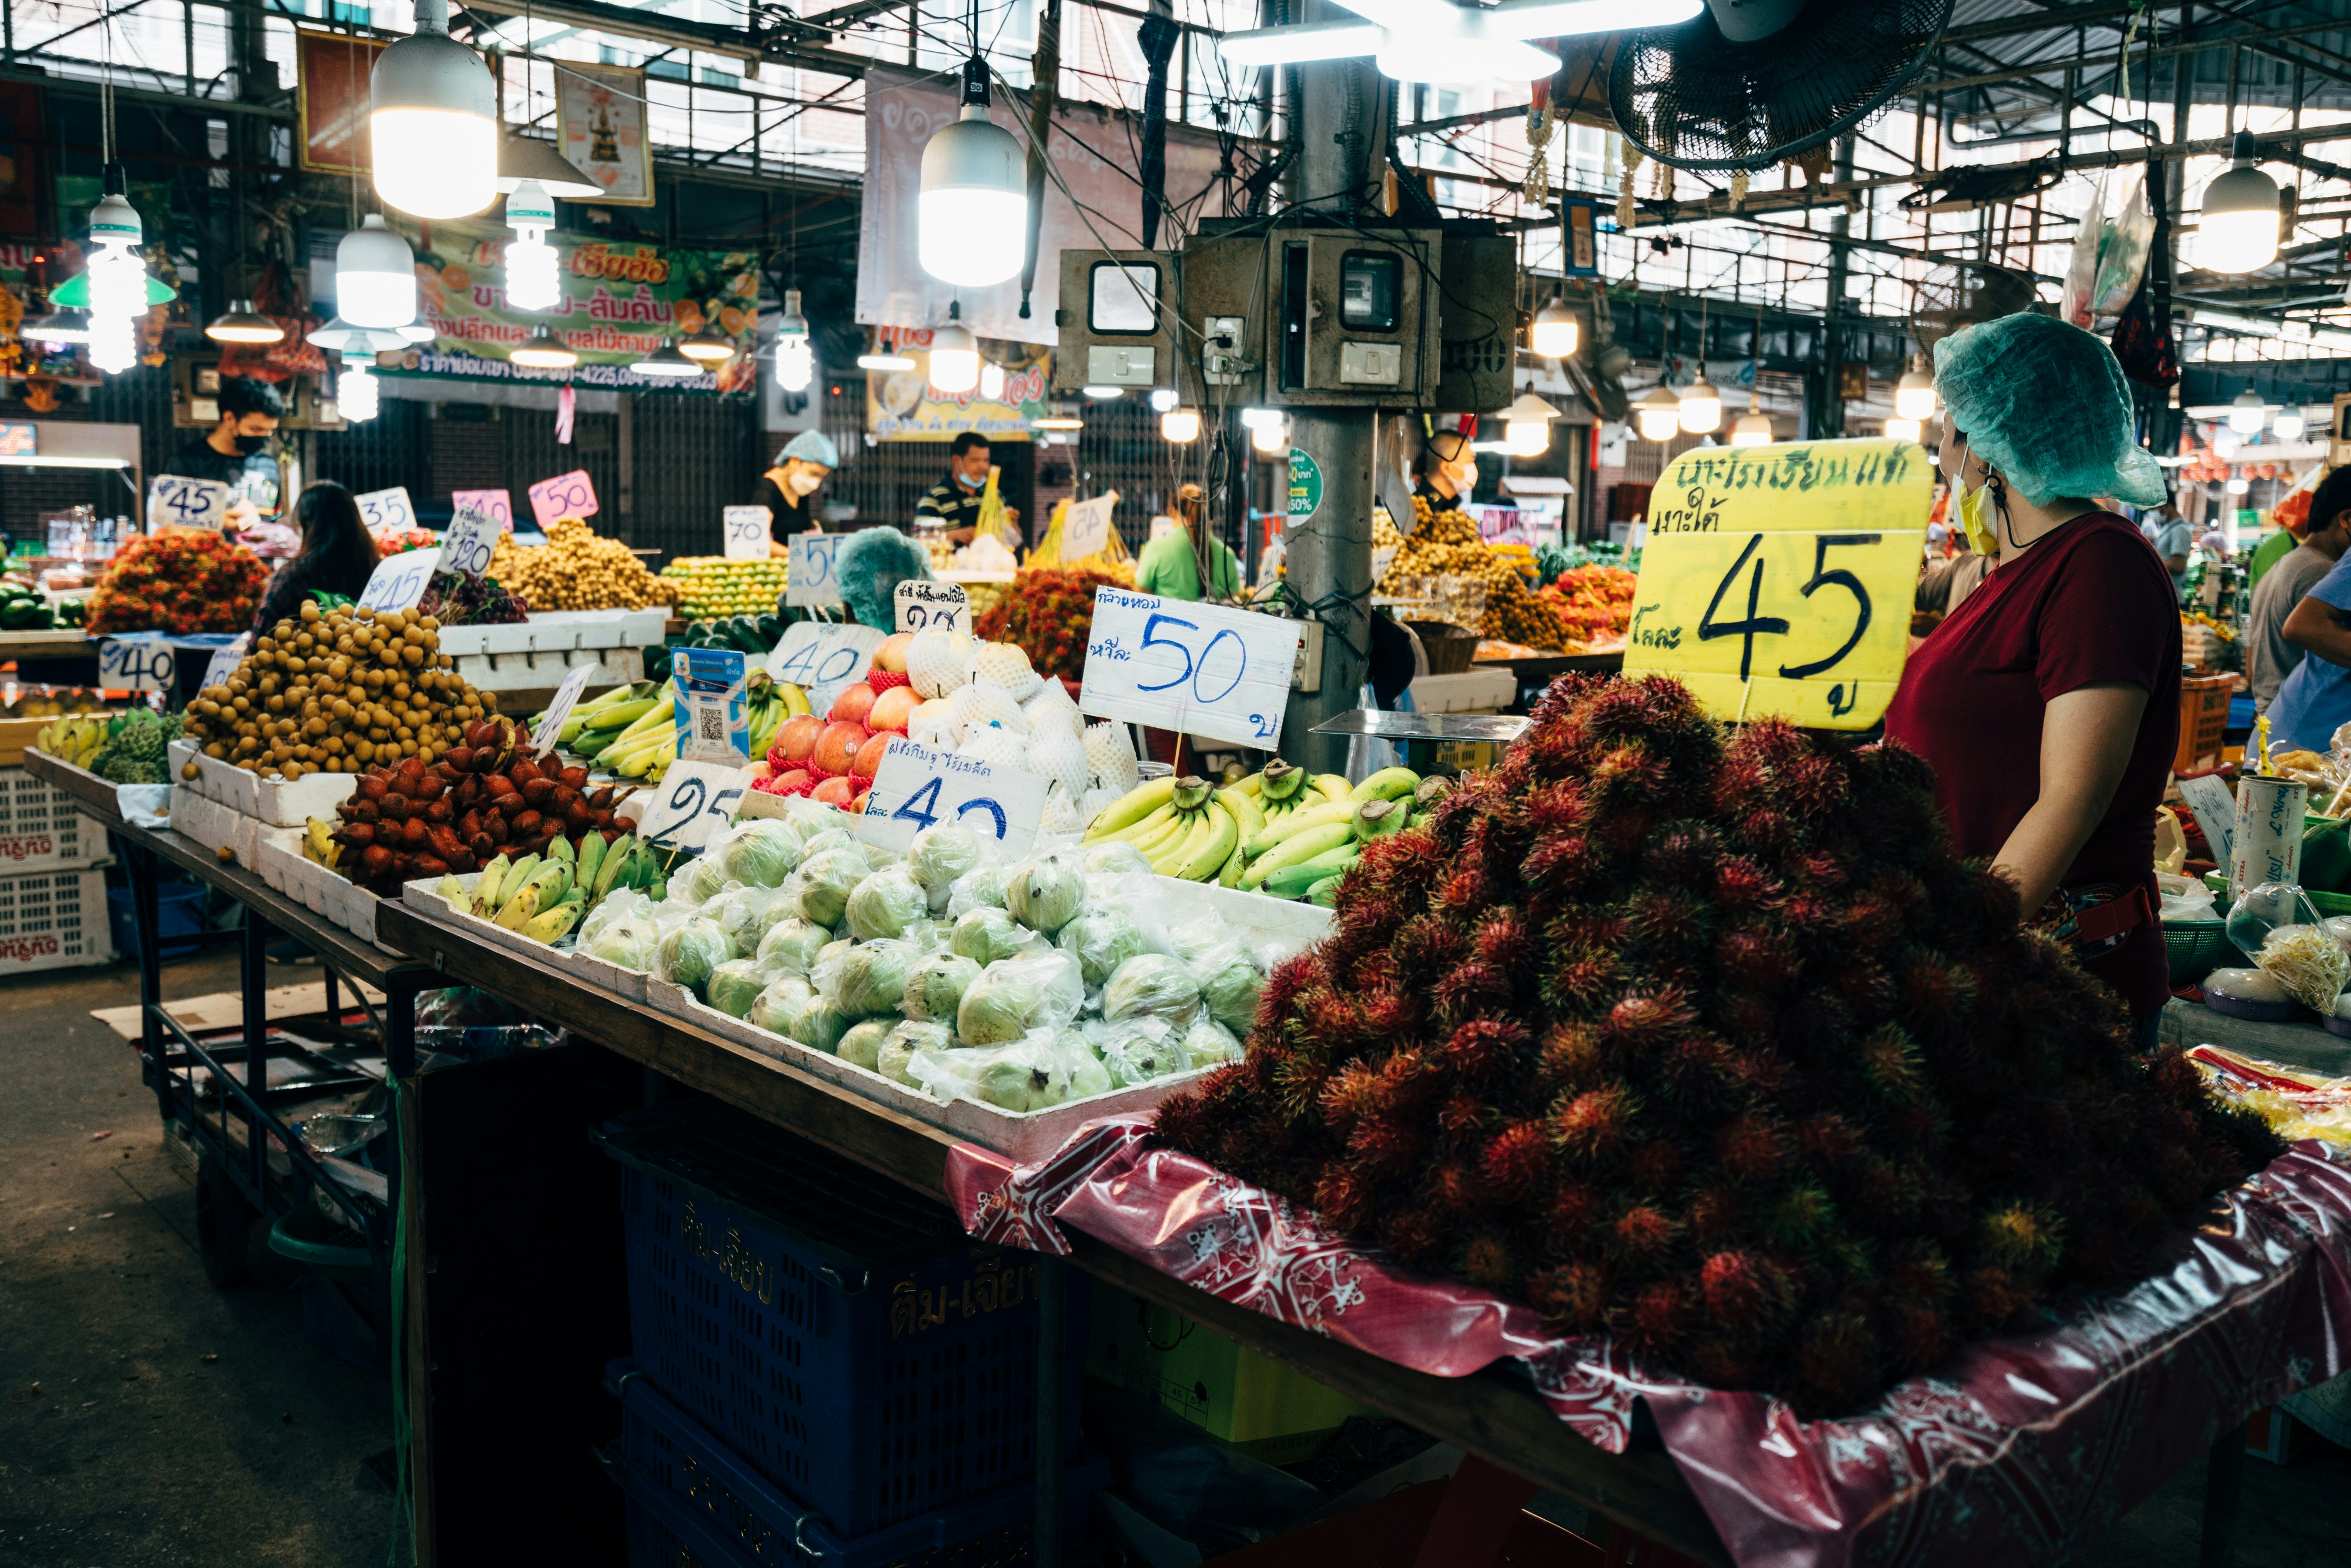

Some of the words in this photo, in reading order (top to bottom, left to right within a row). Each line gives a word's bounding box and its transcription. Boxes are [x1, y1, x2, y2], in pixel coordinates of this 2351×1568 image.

[168, 487, 216, 517] 45
[362, 495, 406, 527] 35
[547, 484, 587, 517] 50
[729, 521, 762, 542] 70
[374, 566, 425, 613] 45
[1098, 588, 1161, 610] กล้วยหอม
[1698, 533, 1882, 682] 45
[120, 648, 173, 687] 40
[782, 641, 860, 684] 40
[1091, 636, 1131, 661] หวีละ
[1137, 613, 1246, 704] 50
[648, 777, 744, 855] 25
[891, 776, 1007, 841] 40
